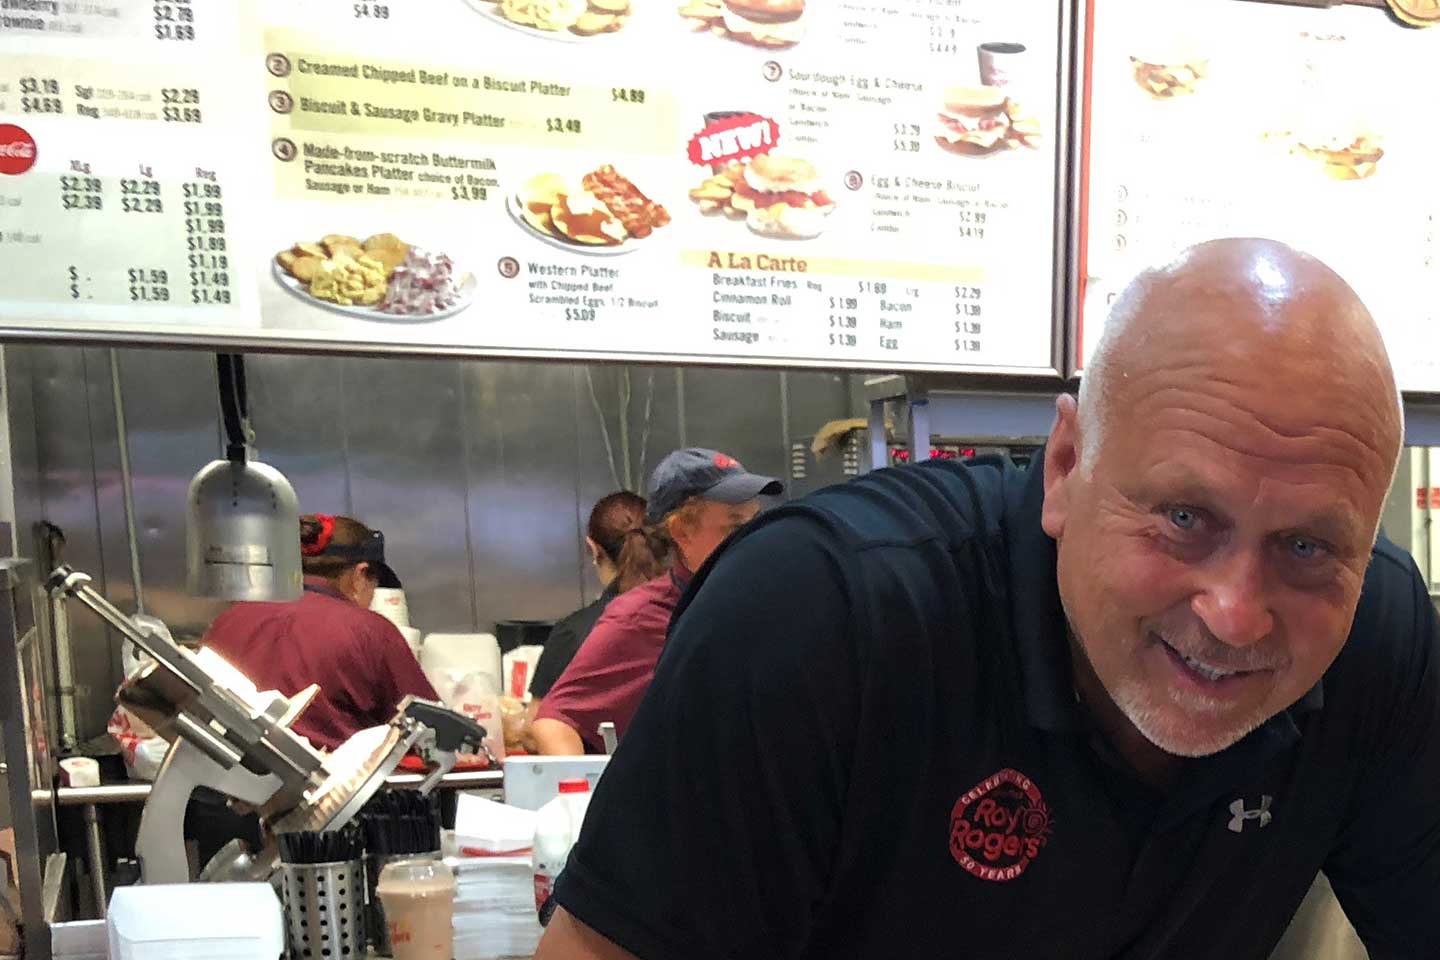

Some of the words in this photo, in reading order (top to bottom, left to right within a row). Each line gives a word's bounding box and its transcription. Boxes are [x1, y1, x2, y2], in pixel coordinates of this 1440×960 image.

[298, 58, 359, 78] Creamed
[362, 64, 416, 84] Chipped
[419, 69, 448, 86] Beef
[452, 76, 468, 87] on
[472, 78, 480, 89] a
[483, 76, 526, 94] Biscuit
[530, 80, 571, 96] Platter
[300, 97, 347, 115] Biscuit
[350, 101, 361, 116] &
[363, 102, 419, 123] Sausage
[423, 108, 459, 127] Gravy
[463, 111, 505, 128] Platter
[699, 120, 772, 161] NEW!
[304, 160, 368, 179] Pancakes
[372, 164, 414, 181] Platter
[432, 153, 496, 170] Buttermilk
[305, 178, 350, 196] Sausage
[366, 182, 390, 195] Ham
[528, 262, 577, 276] Western
[580, 264, 620, 278] Platter
[707, 251, 722, 269] A
[728, 252, 751, 270] La
[756, 254, 808, 272] Carte
[713, 273, 767, 287] Breakfast
[770, 276, 798, 289] Fries
[713, 291, 767, 305] Cinnamon
[771, 294, 792, 306] Roll
[880, 299, 912, 312] Bacon
[713, 309, 751, 323] Biscuit
[713, 328, 759, 344] Sausage
[880, 335, 899, 350] Egg
[974, 798, 1023, 834] Roy
